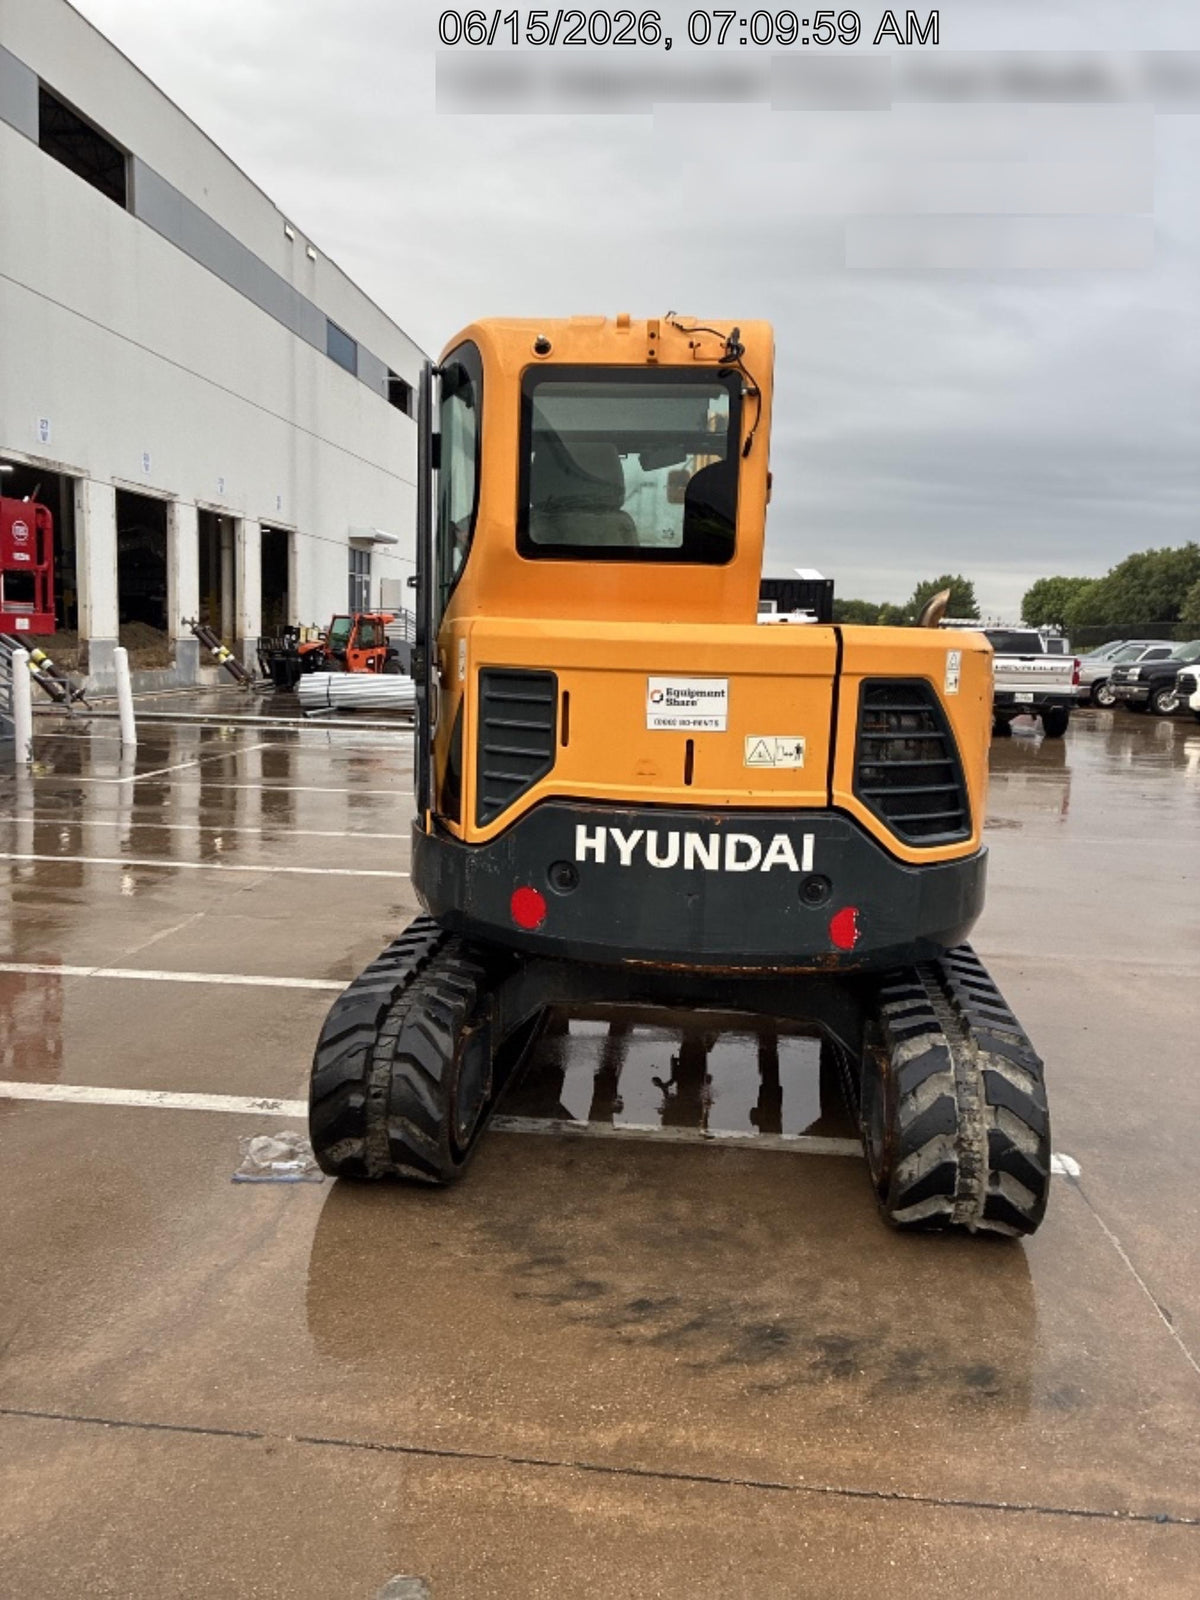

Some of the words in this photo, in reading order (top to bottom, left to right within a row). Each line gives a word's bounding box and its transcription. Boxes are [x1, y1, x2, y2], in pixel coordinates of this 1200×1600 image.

[666, 688, 725, 699] Equipment
[666, 698, 697, 706] Share
[575, 824, 815, 872] HYUNDAI
